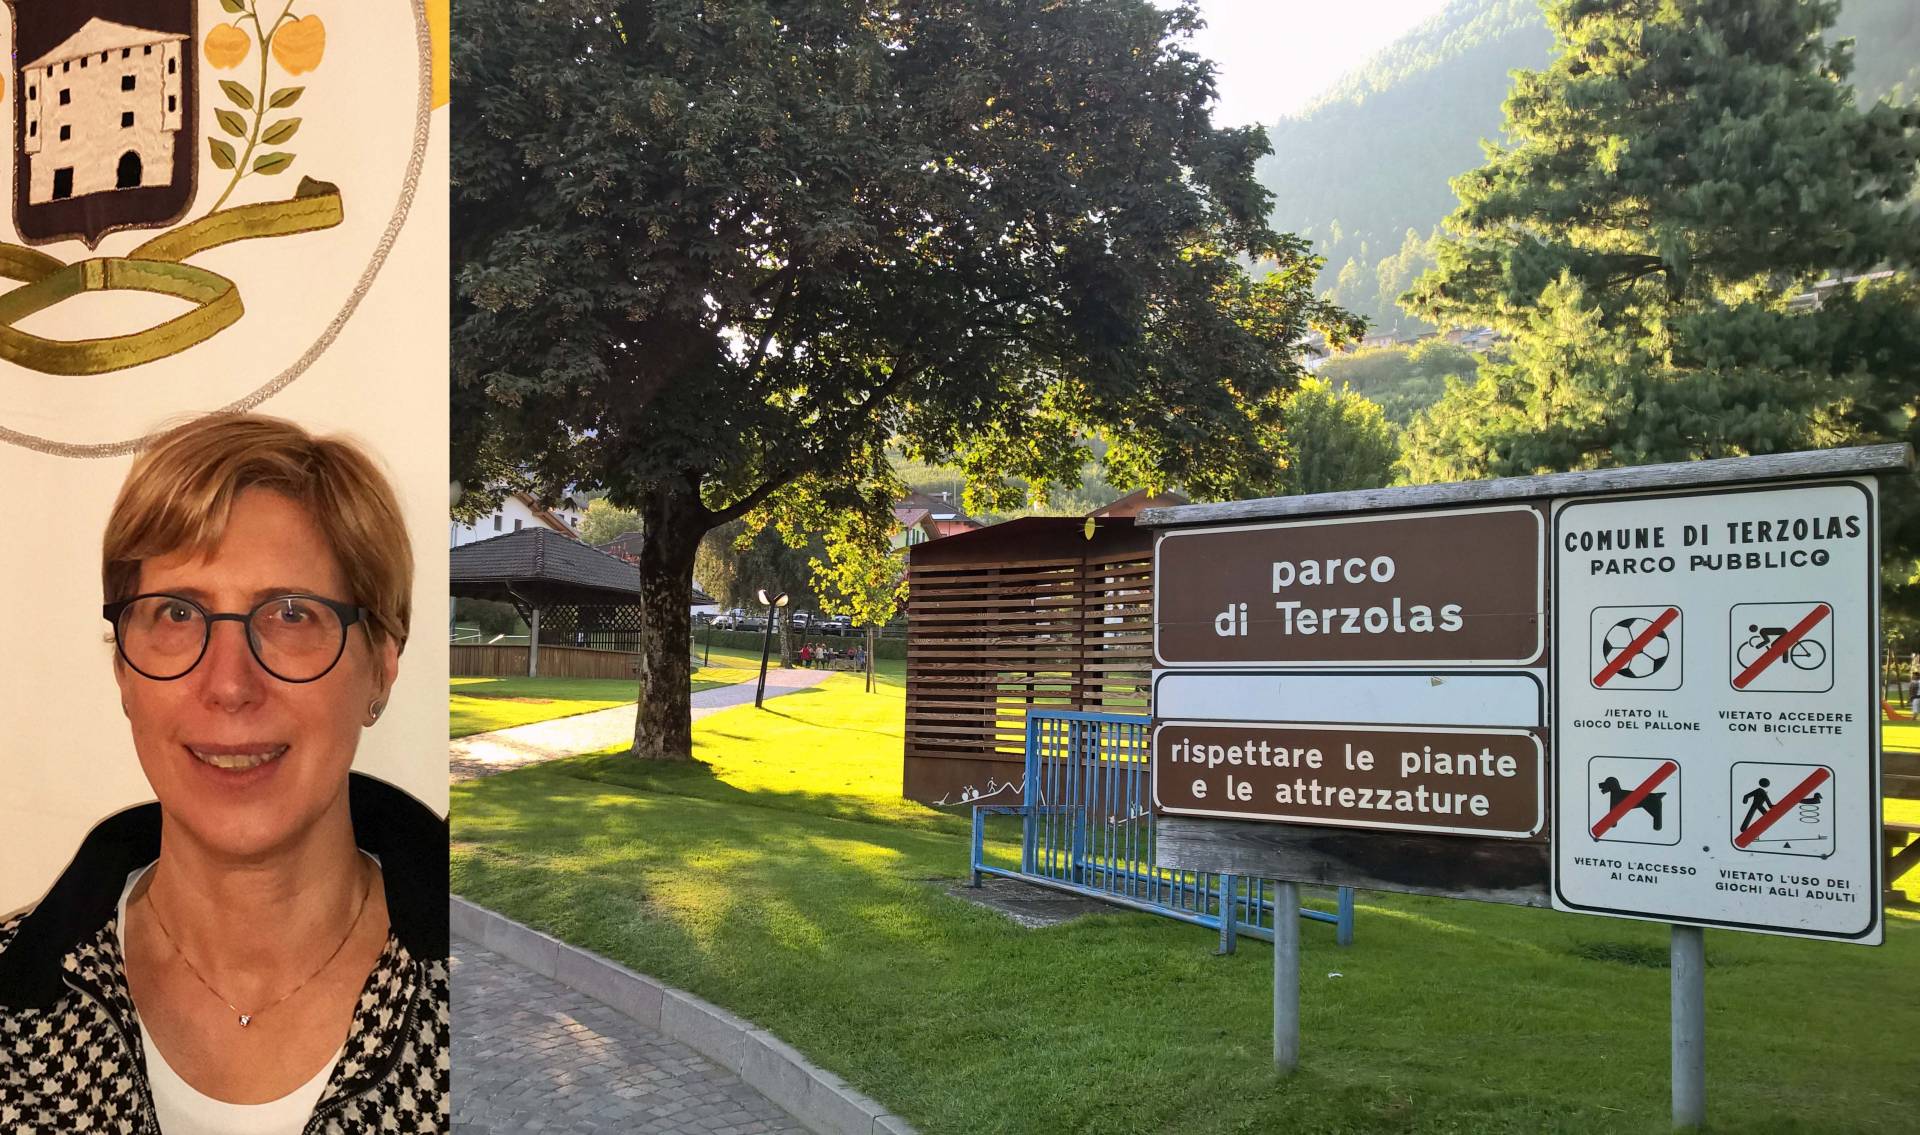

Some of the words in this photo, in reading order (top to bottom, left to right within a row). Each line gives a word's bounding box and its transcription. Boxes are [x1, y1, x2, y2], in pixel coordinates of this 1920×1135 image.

[1565, 527, 1665, 552] COMUNE
[1683, 524, 1708, 546] DI
[1727, 516, 1861, 544] TERZOLAS
[1591, 556, 1676, 576] PARCO
[1690, 549, 1830, 571] PUBBLICO
[1272, 555, 1396, 593] parco
[1214, 603, 1248, 636] di
[1275, 597, 1464, 635] Terzolas
[1658, 710, 1669, 718] IL
[1719, 710, 1772, 722] VIETATO
[1779, 712, 1853, 723] ACCEDERE
[1573, 720, 1611, 728] GIOCO
[1617, 720, 1639, 729] DEL
[1645, 721, 1701, 731] PALLONE
[1728, 723, 1757, 733] CON
[1764, 723, 1843, 735] BICICLETTE
[1171, 738, 1323, 769] rispettare
[1345, 744, 1375, 771] le
[1401, 746, 1518, 778] piante
[1192, 778, 1207, 799] e
[1227, 775, 1253, 801] le
[1275, 778, 1490, 817] attrezzature
[1574, 857, 1622, 868] VIETATO
[1628, 861, 1697, 876] L'ACCESSO
[1610, 872, 1622, 880] AI
[1628, 873, 1658, 884] CANI
[1720, 869, 1773, 882] VIETATO
[1780, 874, 1820, 886] L'USO
[1827, 878, 1850, 889] DEI
[1715, 882, 1762, 894] GIOCHI
[1769, 886, 1799, 897] AGLI
[1806, 890, 1855, 903] ADULTI
